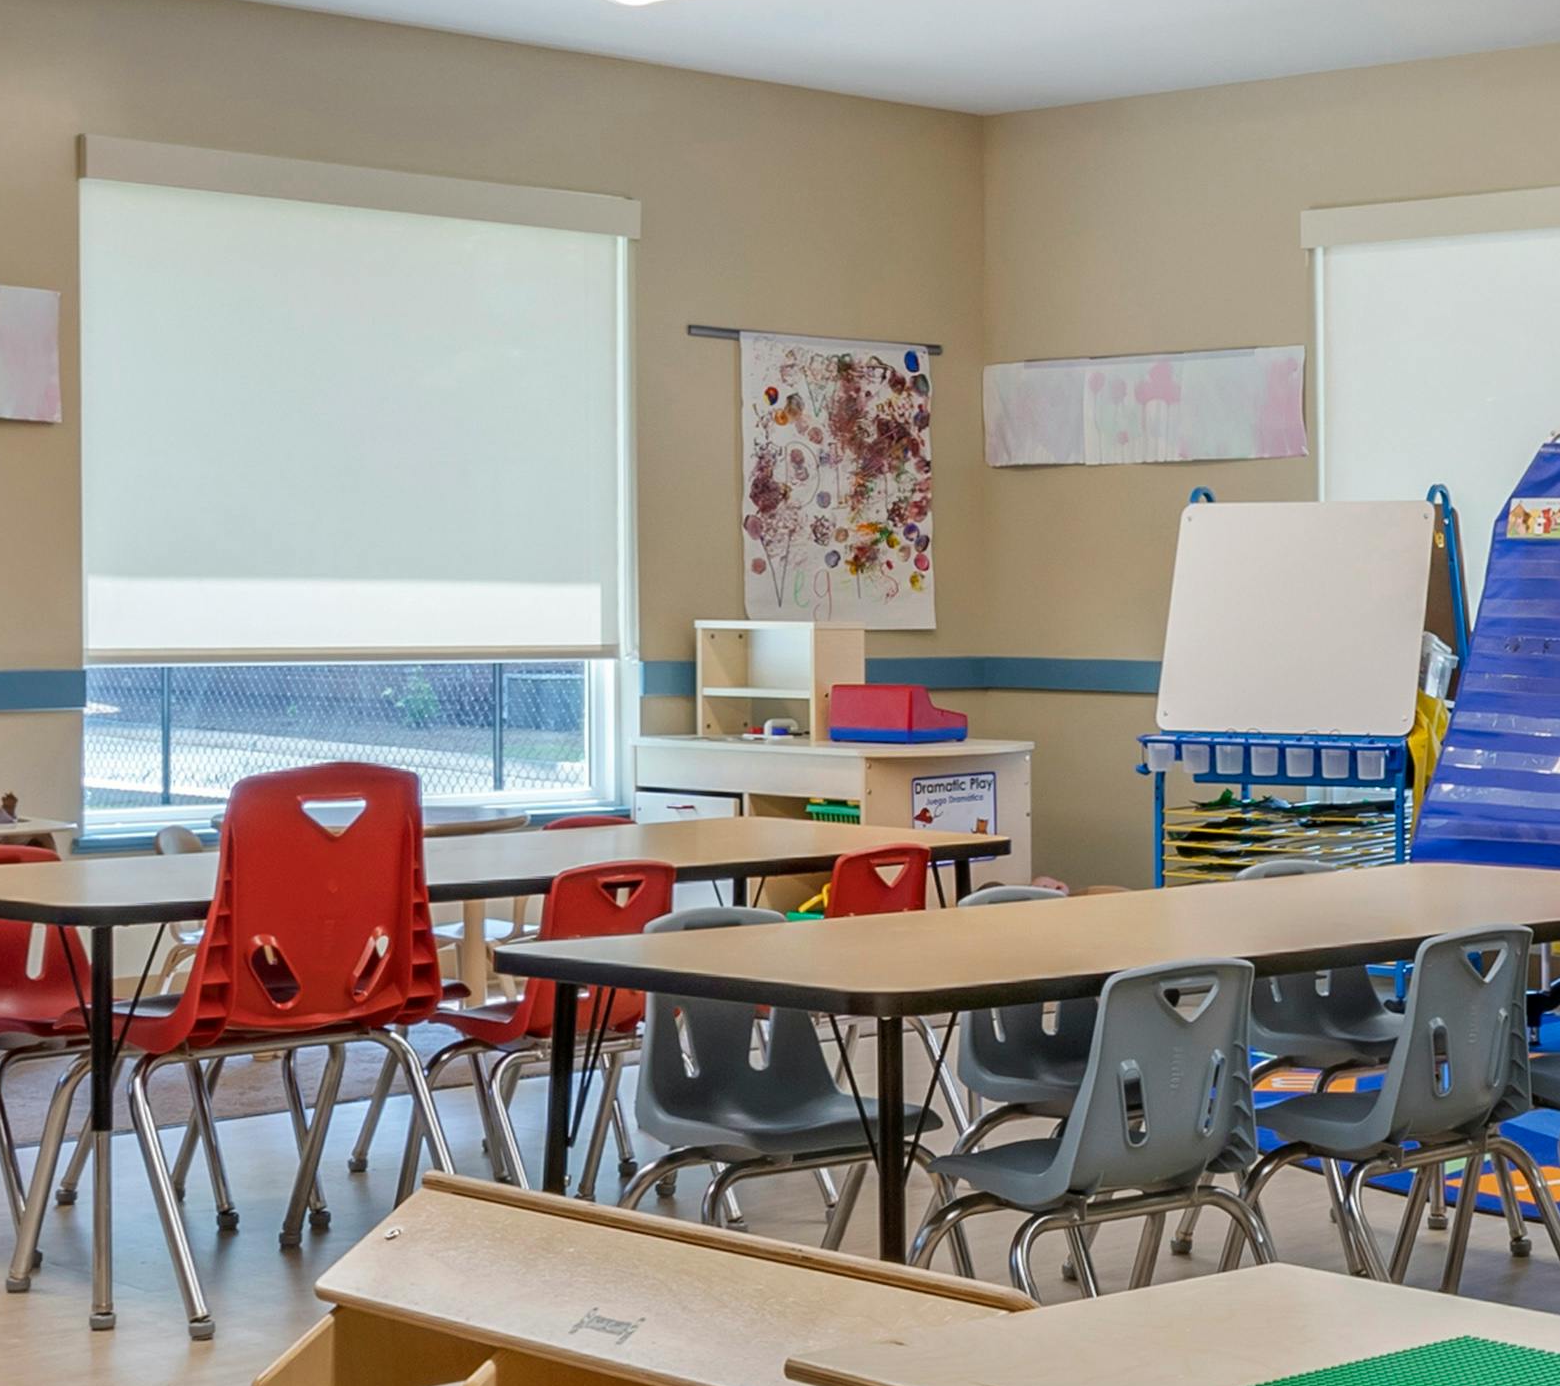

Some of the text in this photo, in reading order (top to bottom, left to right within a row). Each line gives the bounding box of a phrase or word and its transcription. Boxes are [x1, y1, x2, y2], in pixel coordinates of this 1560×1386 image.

[914, 777, 993, 795] Dramatic Play
[925, 797, 947, 806] Juego
